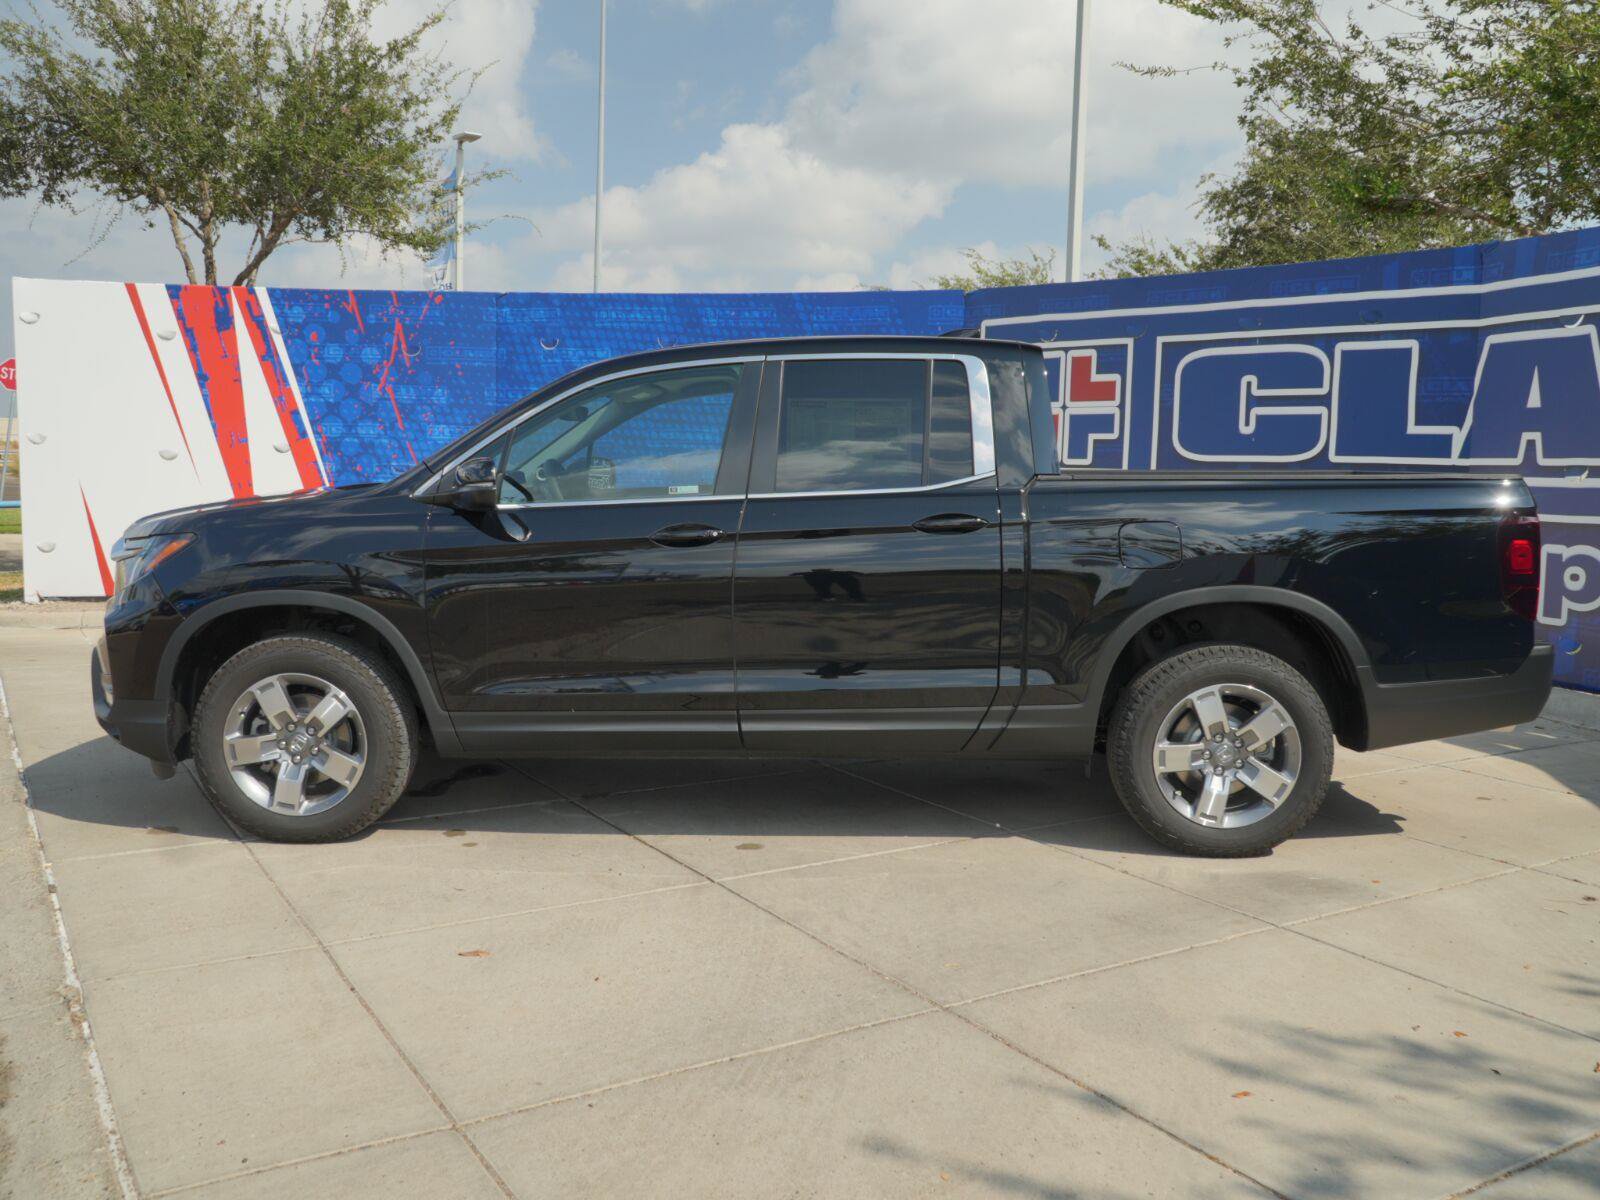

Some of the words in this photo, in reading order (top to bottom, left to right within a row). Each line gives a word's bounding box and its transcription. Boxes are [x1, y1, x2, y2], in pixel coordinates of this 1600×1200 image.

[1, 366, 16, 380] ST
[1171, 325, 1600, 466] CLA
[1536, 544, 1600, 626] p
